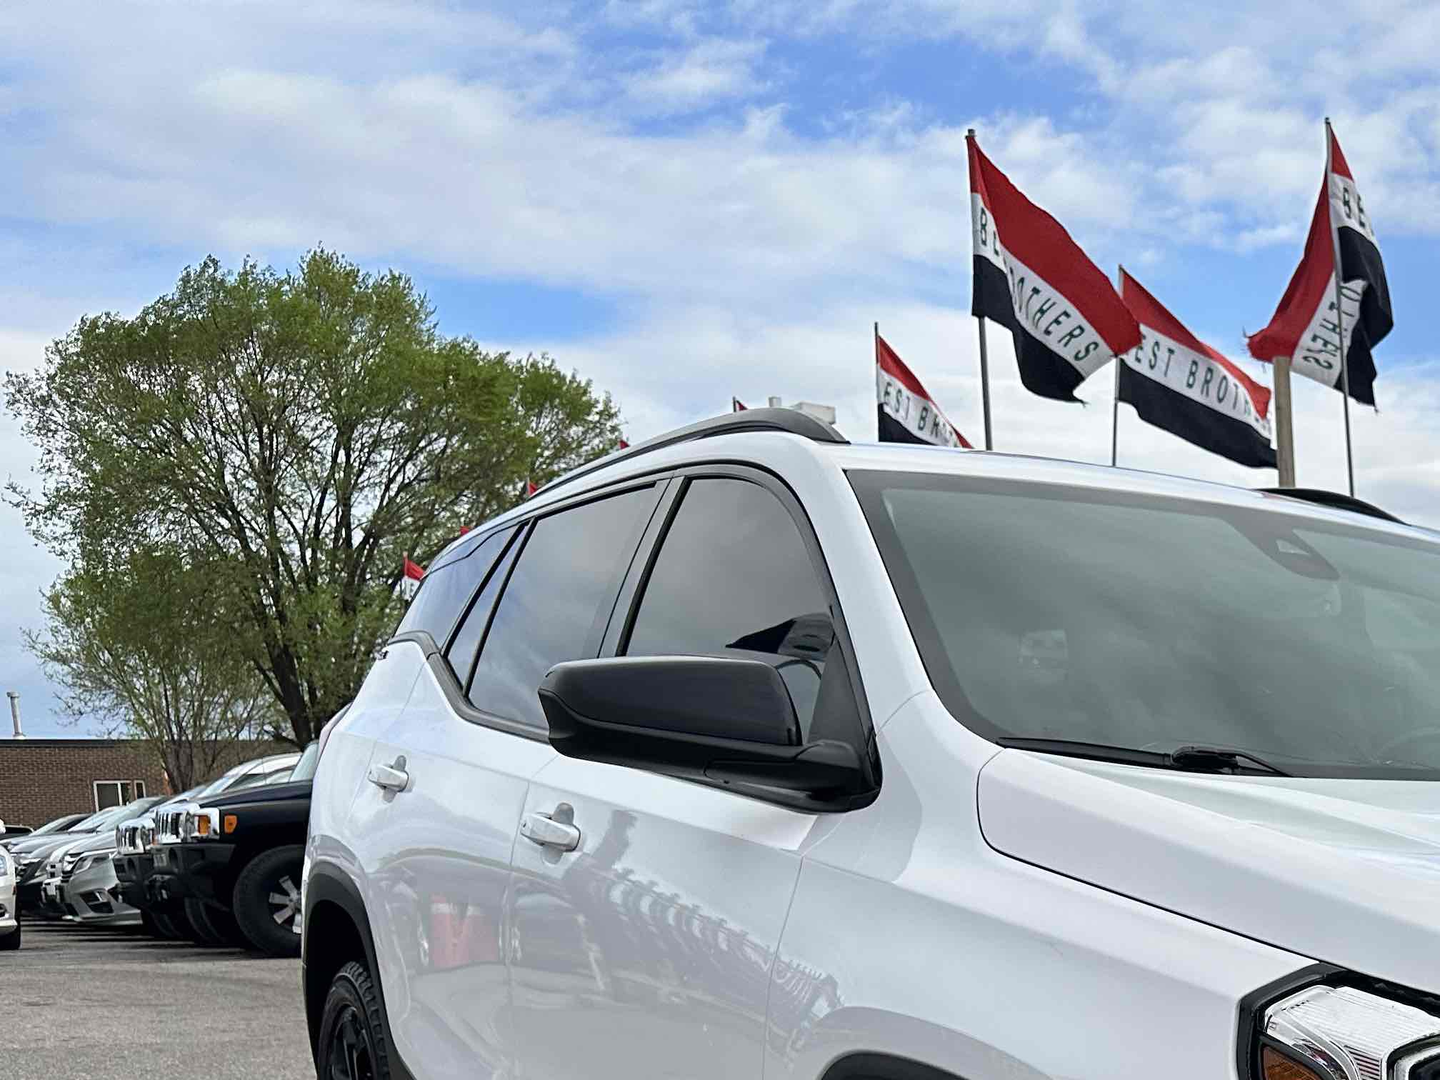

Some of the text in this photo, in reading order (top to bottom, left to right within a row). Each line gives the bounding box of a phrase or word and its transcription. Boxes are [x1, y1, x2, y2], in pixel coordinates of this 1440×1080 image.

[1011, 269, 1099, 362] OTHERS
[1135, 332, 1175, 378] EST
[883, 381, 911, 421] EST
